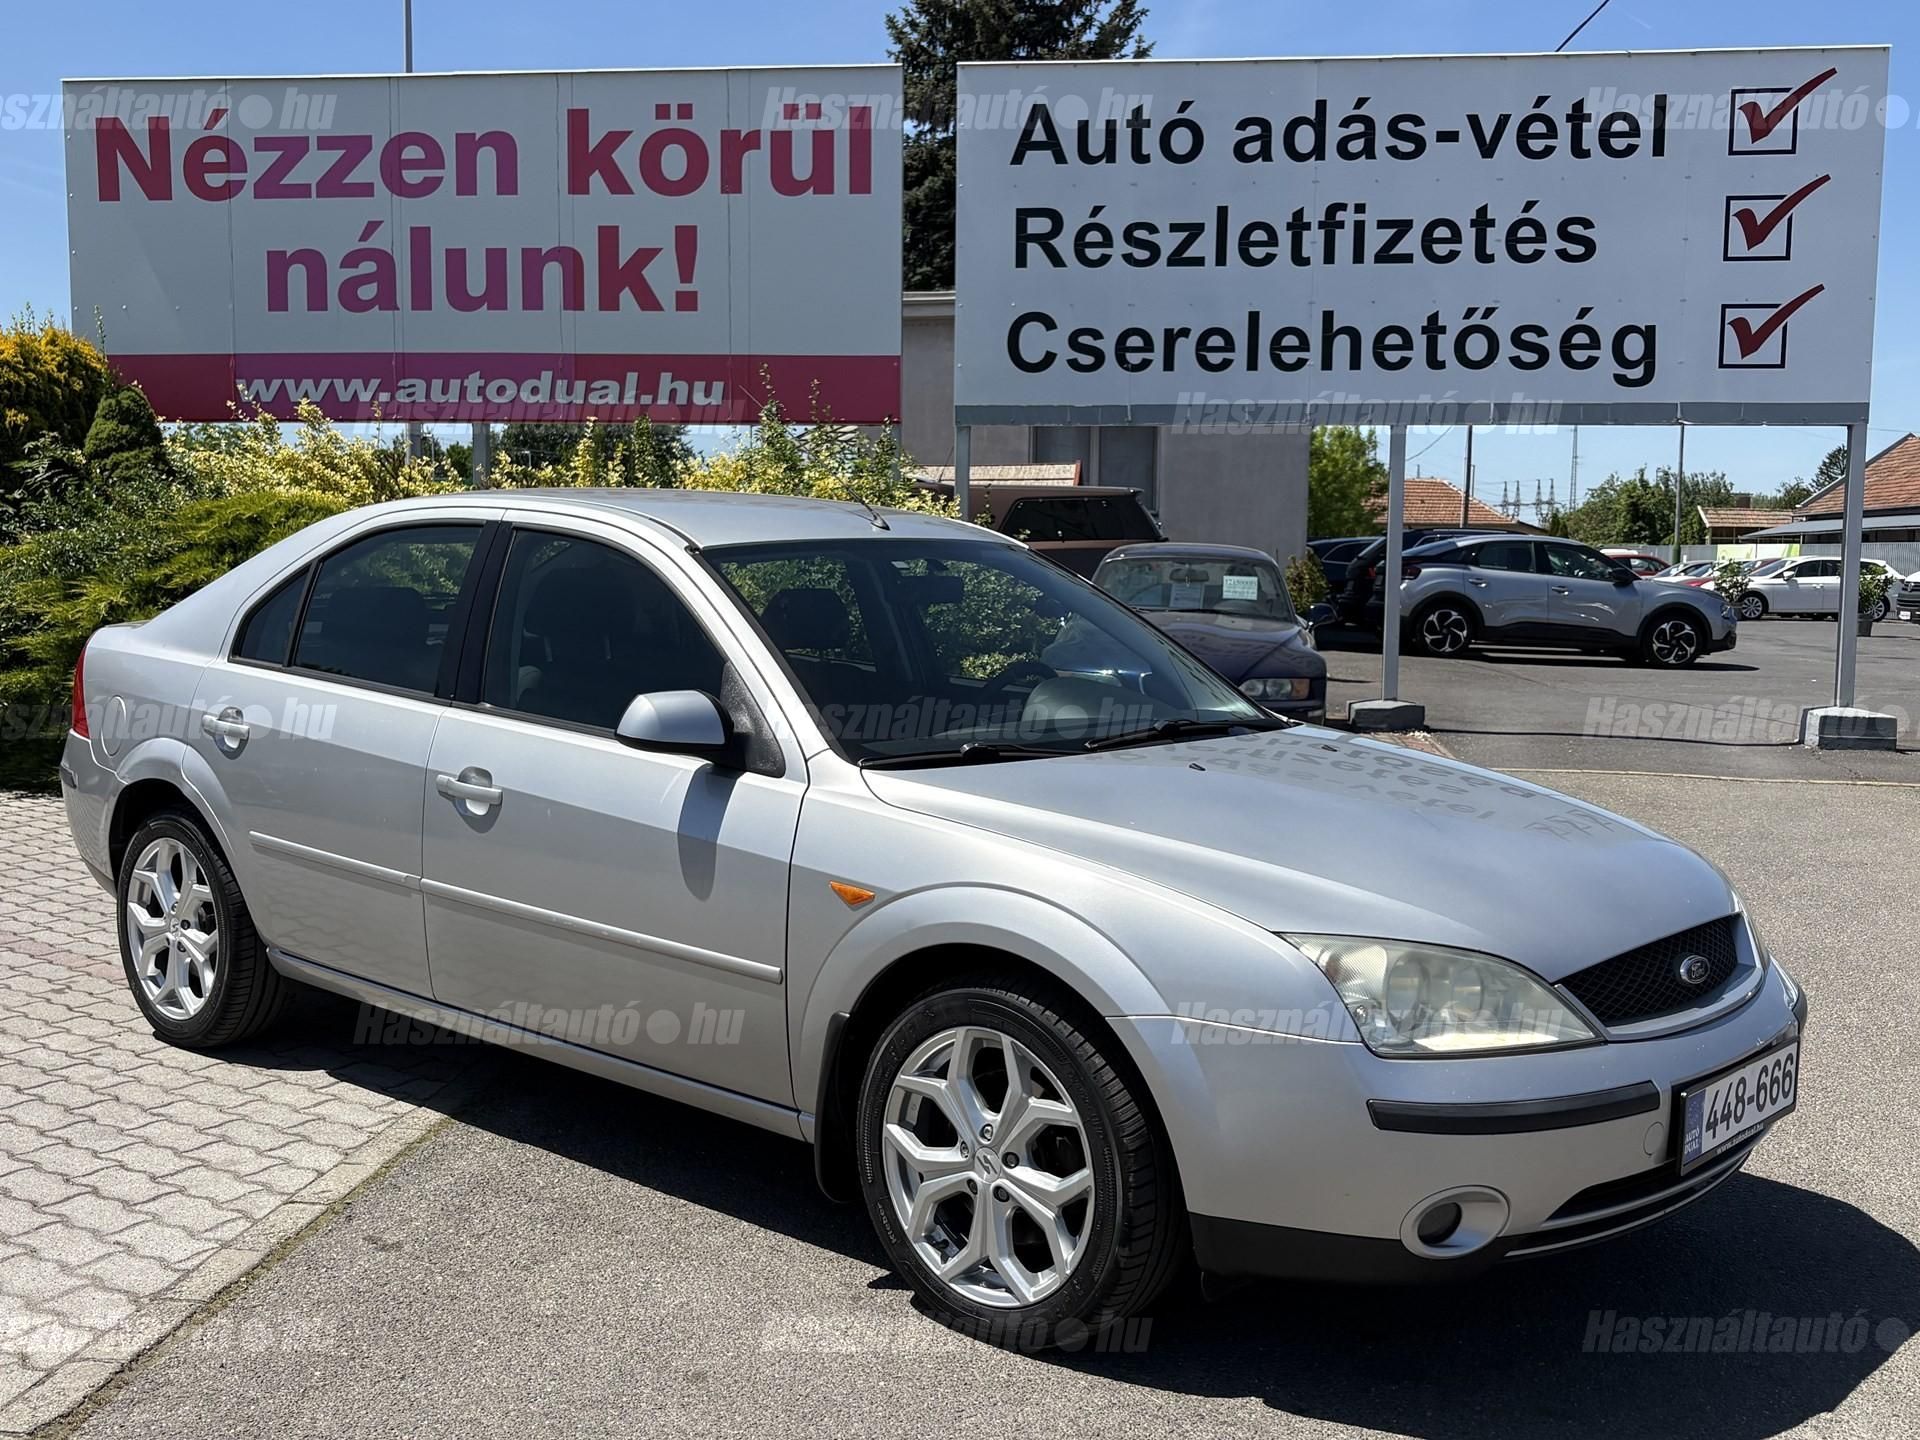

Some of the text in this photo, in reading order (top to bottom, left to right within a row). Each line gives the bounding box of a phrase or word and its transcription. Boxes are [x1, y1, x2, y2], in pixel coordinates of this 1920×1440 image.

[96, 104, 872, 202] Nézzen körül
[1010, 94, 1668, 167] Autó adás-vétel
[267, 220, 700, 313] nálunk!
[1015, 200, 1599, 270] Részletfizetés
[237, 370, 726, 407] www.autodual.hu
[1007, 306, 1658, 389] Cserelehetőség
[1704, 1052, 1795, 1140] 448-666
